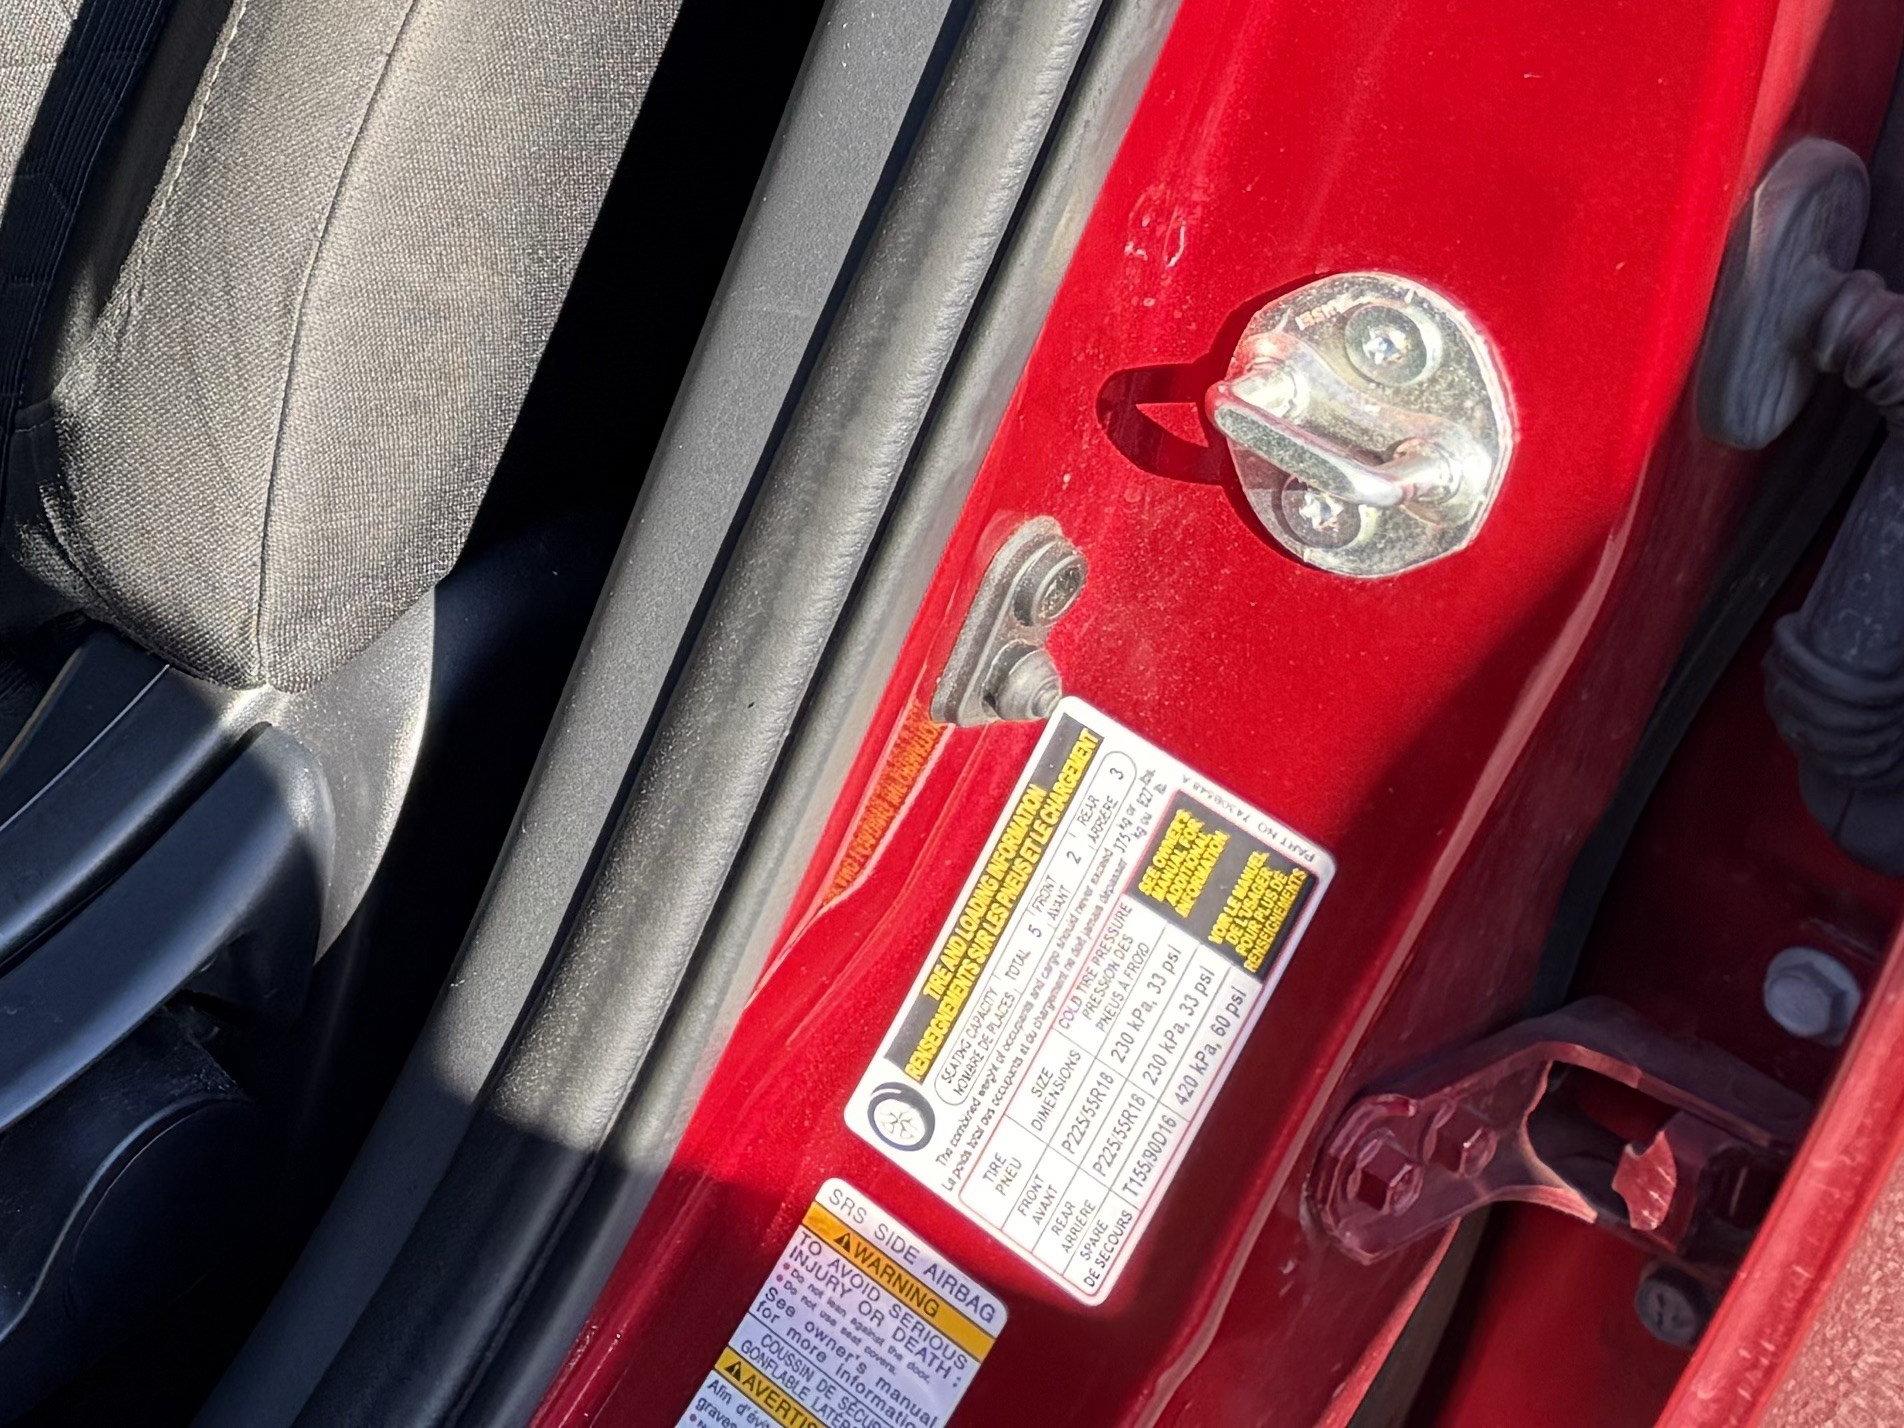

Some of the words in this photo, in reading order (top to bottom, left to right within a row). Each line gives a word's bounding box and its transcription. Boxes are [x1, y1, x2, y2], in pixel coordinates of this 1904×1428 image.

[1036, 726, 1102, 827] CHARGEMENT
[1108, 765, 1126, 781] 3
[983, 781, 1049, 881] INFORMATION
[1026, 816, 1055, 846] LE
[1075, 793, 1100, 826] REAR
[1017, 835, 1045, 865] ET
[1064, 848, 1082, 865] 2
[1148, 844, 1189, 903] MANUAL
[1176, 814, 1204, 850] FOR
[1162, 827, 1214, 908] ADDITIONAL
[1278, 833, 1317, 864] PART
[993, 853, 1035, 910] PNEUS
[1030, 873, 1058, 913] FRONT
[1135, 862, 1162, 896] SEE
[1172, 827, 1232, 919] INFORMATION
[1230, 844, 1270, 902] MANUEL
[952, 871, 1002, 942] LOADING
[980, 899, 1011, 936] LES
[1044, 883, 1072, 921] AVANT
[1221, 894, 1243, 918] LE
[1233, 916, 1264, 958] POUR
[1251, 885, 1281, 924] PLUS
[1267, 868, 1289, 893] DE
[1240, 865, 1309, 974] RENSEIGNEMENTS
[964, 925, 998, 966] SUR
[1206, 910, 1235, 947] VOIR
[1223, 922, 1244, 947] DE
[937, 933, 969, 972] AND
[1003, 944, 1031, 982] TOTAL
[1025, 922, 1044, 939] 5
[1056, 993, 1084, 1031] COLD
[1074, 964, 1099, 996] TIRE
[1089, 900, 1133, 968] PRESSURE
[920, 961, 954, 1004] TIRE
[1079, 957, 1121, 1021] PRESSION
[1111, 931, 1135, 961] DES
[1188, 963, 1219, 998] psi
[902, 954, 982, 1083] RENSEIGNEMENTS
[985, 990, 1016, 1035] PLACES
[1093, 988, 1126, 1034] PNEUS
[1108, 1028, 1137, 1064] 230
[1125, 991, 1159, 1035] kPa,
[1145, 970, 1168, 996] 33
[1157, 942, 1186, 976] psi
[1177, 991, 1201, 1018] 33
[1219, 983, 1251, 1019] psi
[939, 1037, 972, 1085] SEATING
[963, 985, 999, 1040] CAPACITY
[977, 1032, 994, 1052] DE
[1157, 1013, 1192, 1057] kPa,
[1208, 1012, 1233, 1039] 60
[952, 1048, 985, 1098] NOMBRE
[1140, 1050, 1169, 1087] 230
[1187, 1033, 1224, 1079] kPa,
[1029, 1065, 1054, 1099] SIZE
[1029, 1047, 1082, 1132] DIMENSIONS
[1170, 1071, 1200, 1108] 420
[1059, 1068, 1115, 1155] P225/55R18
[1091, 1090, 1148, 1178] P225/55R18
[981, 1150, 1007, 1185] TIRE
[994, 1155, 1023, 1197] PNEU
[1121, 1111, 1179, 1199] T155/90D16
[1016, 1172, 1047, 1218] FRONT
[1029, 1182, 1060, 1227] AVANT
[1049, 1198, 1077, 1238] REAR
[827, 1186, 869, 1226] SRS
[871, 1220, 921, 1266] SIDE
[921, 1258, 999, 1325] AIRBAG
[1078, 1217, 1110, 1263] SPARE
[1082, 1266, 1102, 1290] DE
[1092, 1206, 1135, 1271] SECOURS
[795, 1230, 824, 1260] TO
[826, 1254, 883, 1305] AVOID
[886, 1301, 970, 1372] SERIOUS
[799, 1293, 818, 1312] not
[806, 1281, 825, 1300] not
[851, 1242, 942, 1319] WARNING
[786, 1244, 852, 1302] INJURY
[854, 1297, 886, 1329] OR
[889, 1324, 953, 1381] DEATH
[738, 1336, 811, 1402] GONFLABLE
[754, 1298, 782, 1327] for
[784, 1324, 829, 1365] more
[833, 1361, 918, 1428] informatio
[758, 1331, 816, 1384] COUSSIN
[814, 1376, 838, 1401] DE
[762, 1284, 799, 1320] See
[801, 1315, 870, 1377] owner's
[873, 1372, 939, 1428] manual
[706, 1375, 735, 1406] Afin
